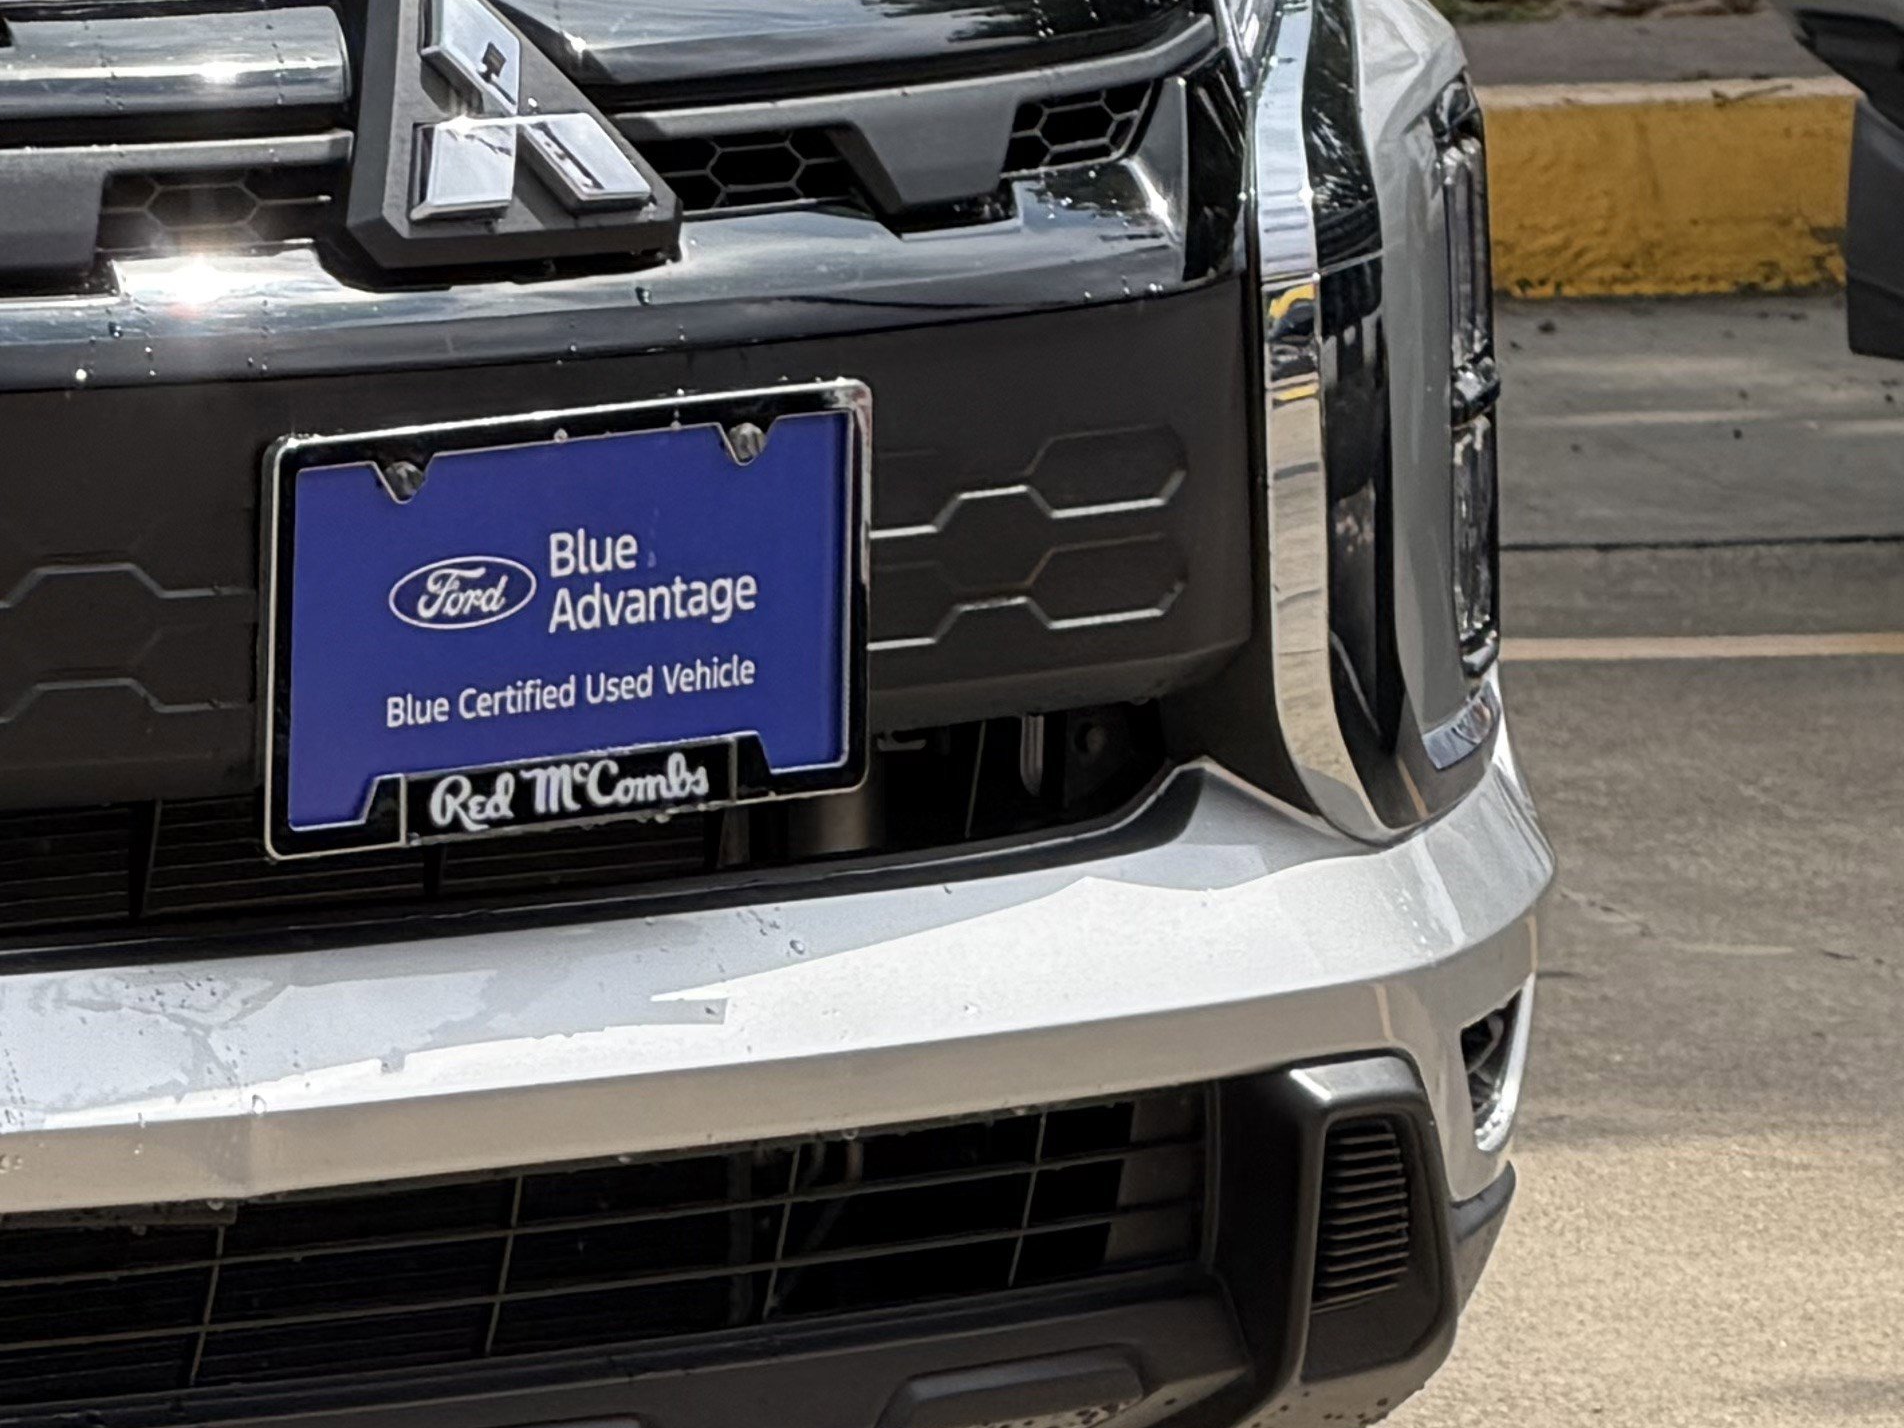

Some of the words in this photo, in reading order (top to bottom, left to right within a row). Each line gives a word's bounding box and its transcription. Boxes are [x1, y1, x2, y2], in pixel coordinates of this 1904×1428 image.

[549, 528, 638, 578] Blue
[417, 566, 508, 619] Ford
[548, 571, 757, 634] Advantage
[386, 694, 450, 728] Blue
[458, 674, 576, 720] Certified
[585, 665, 654, 705] Used
[662, 654, 756, 695] Vehicle
[430, 775, 516, 831] Red
[519, 752, 711, 814] McCombs
